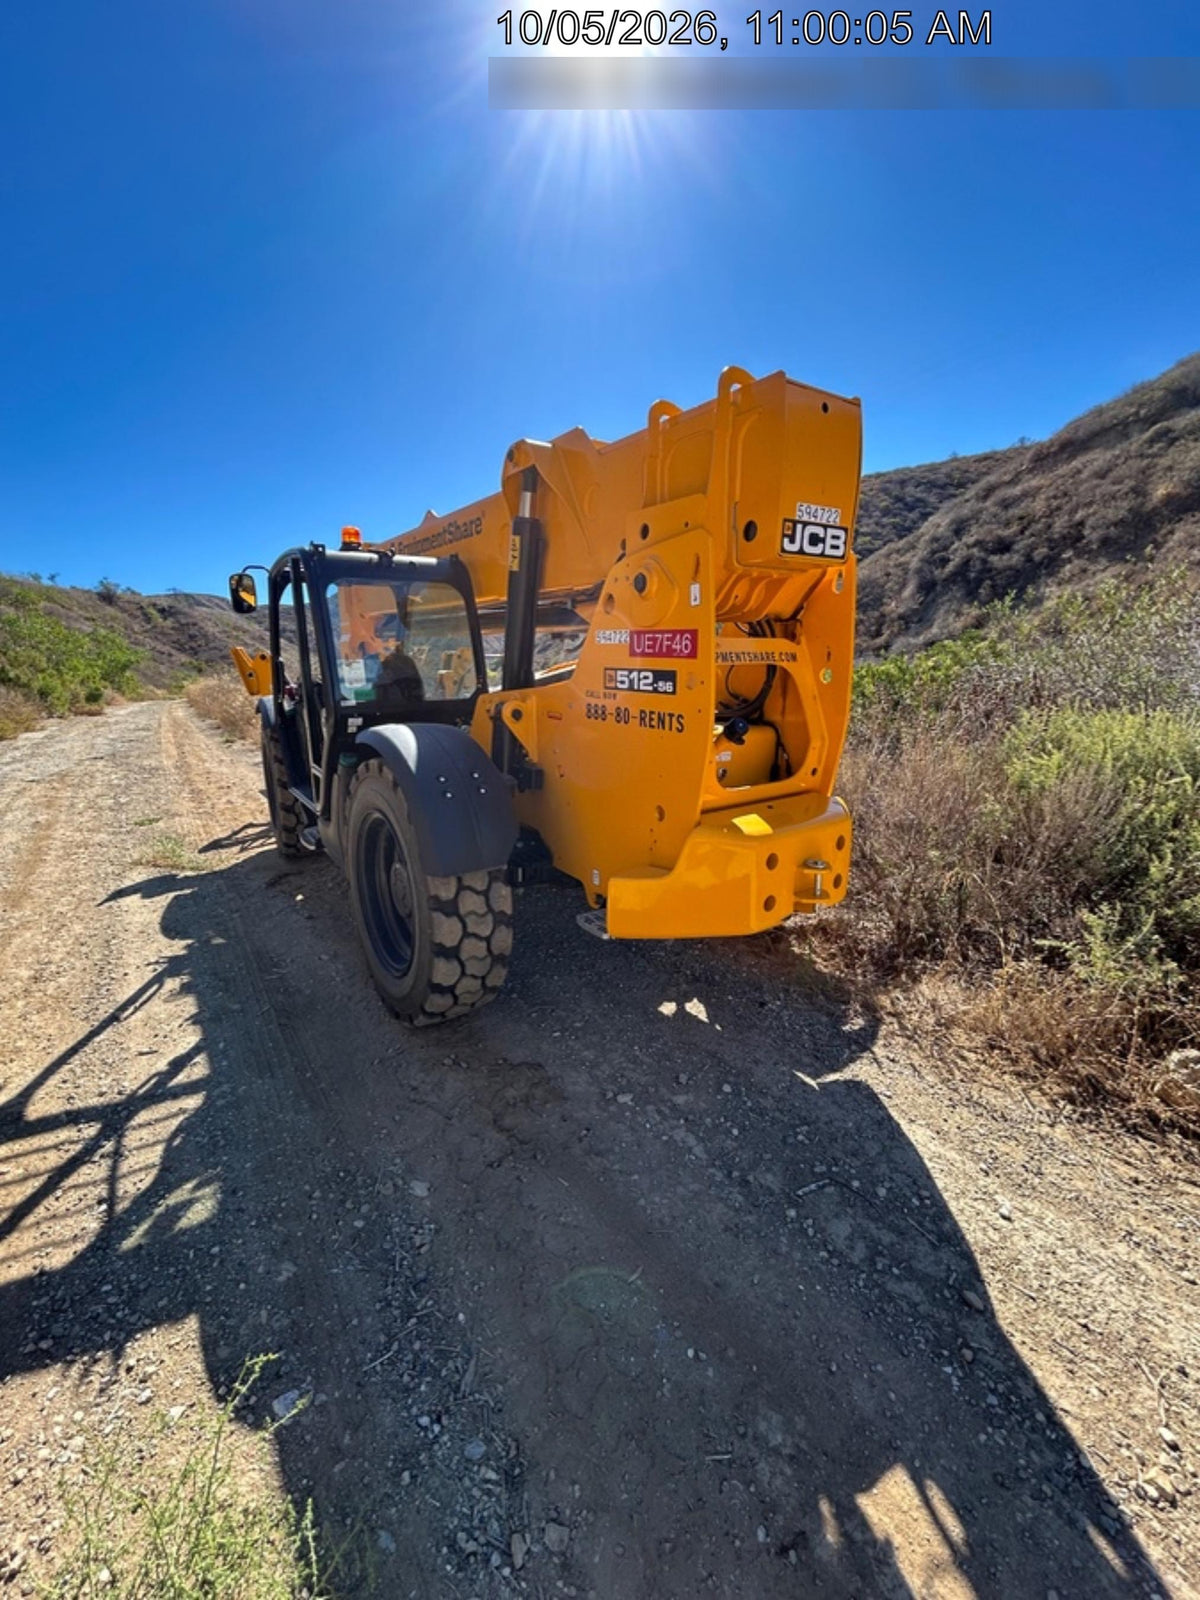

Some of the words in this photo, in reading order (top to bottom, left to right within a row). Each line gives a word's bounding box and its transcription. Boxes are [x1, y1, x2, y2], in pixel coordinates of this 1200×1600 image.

[797, 504, 840, 524] 594722
[783, 523, 846, 557] JCB
[633, 633, 692, 654] UE7F46
[586, 702, 685, 733] 888-80-RENTS
